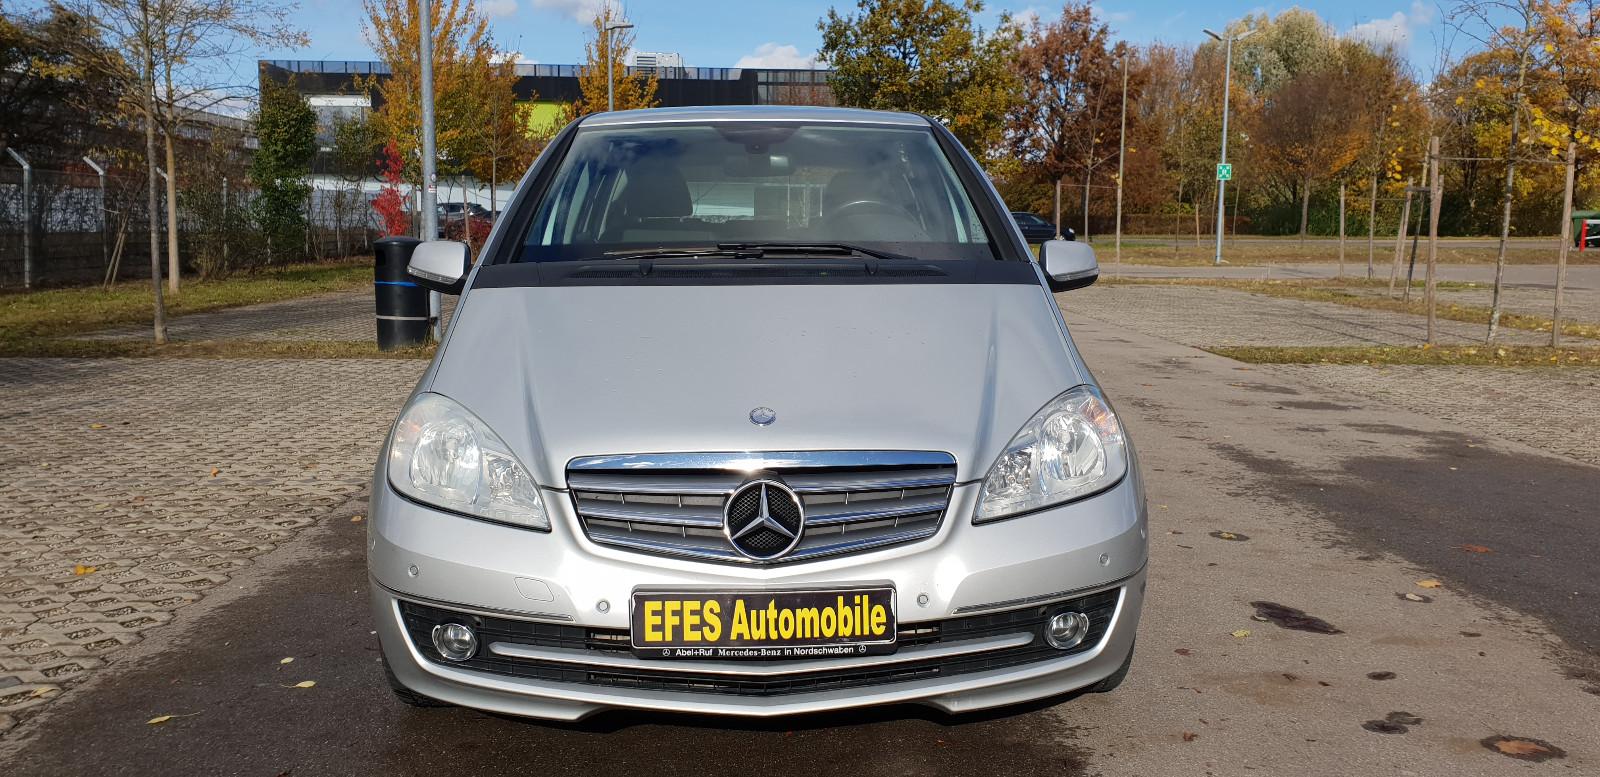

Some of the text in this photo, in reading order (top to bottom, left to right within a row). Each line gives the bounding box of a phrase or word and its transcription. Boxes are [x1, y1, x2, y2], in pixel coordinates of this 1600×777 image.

[644, 594, 887, 642] EFES Automobile
[675, 646, 854, 656] Abel+Ruf Mercedes-Benz in Nordschwaben
